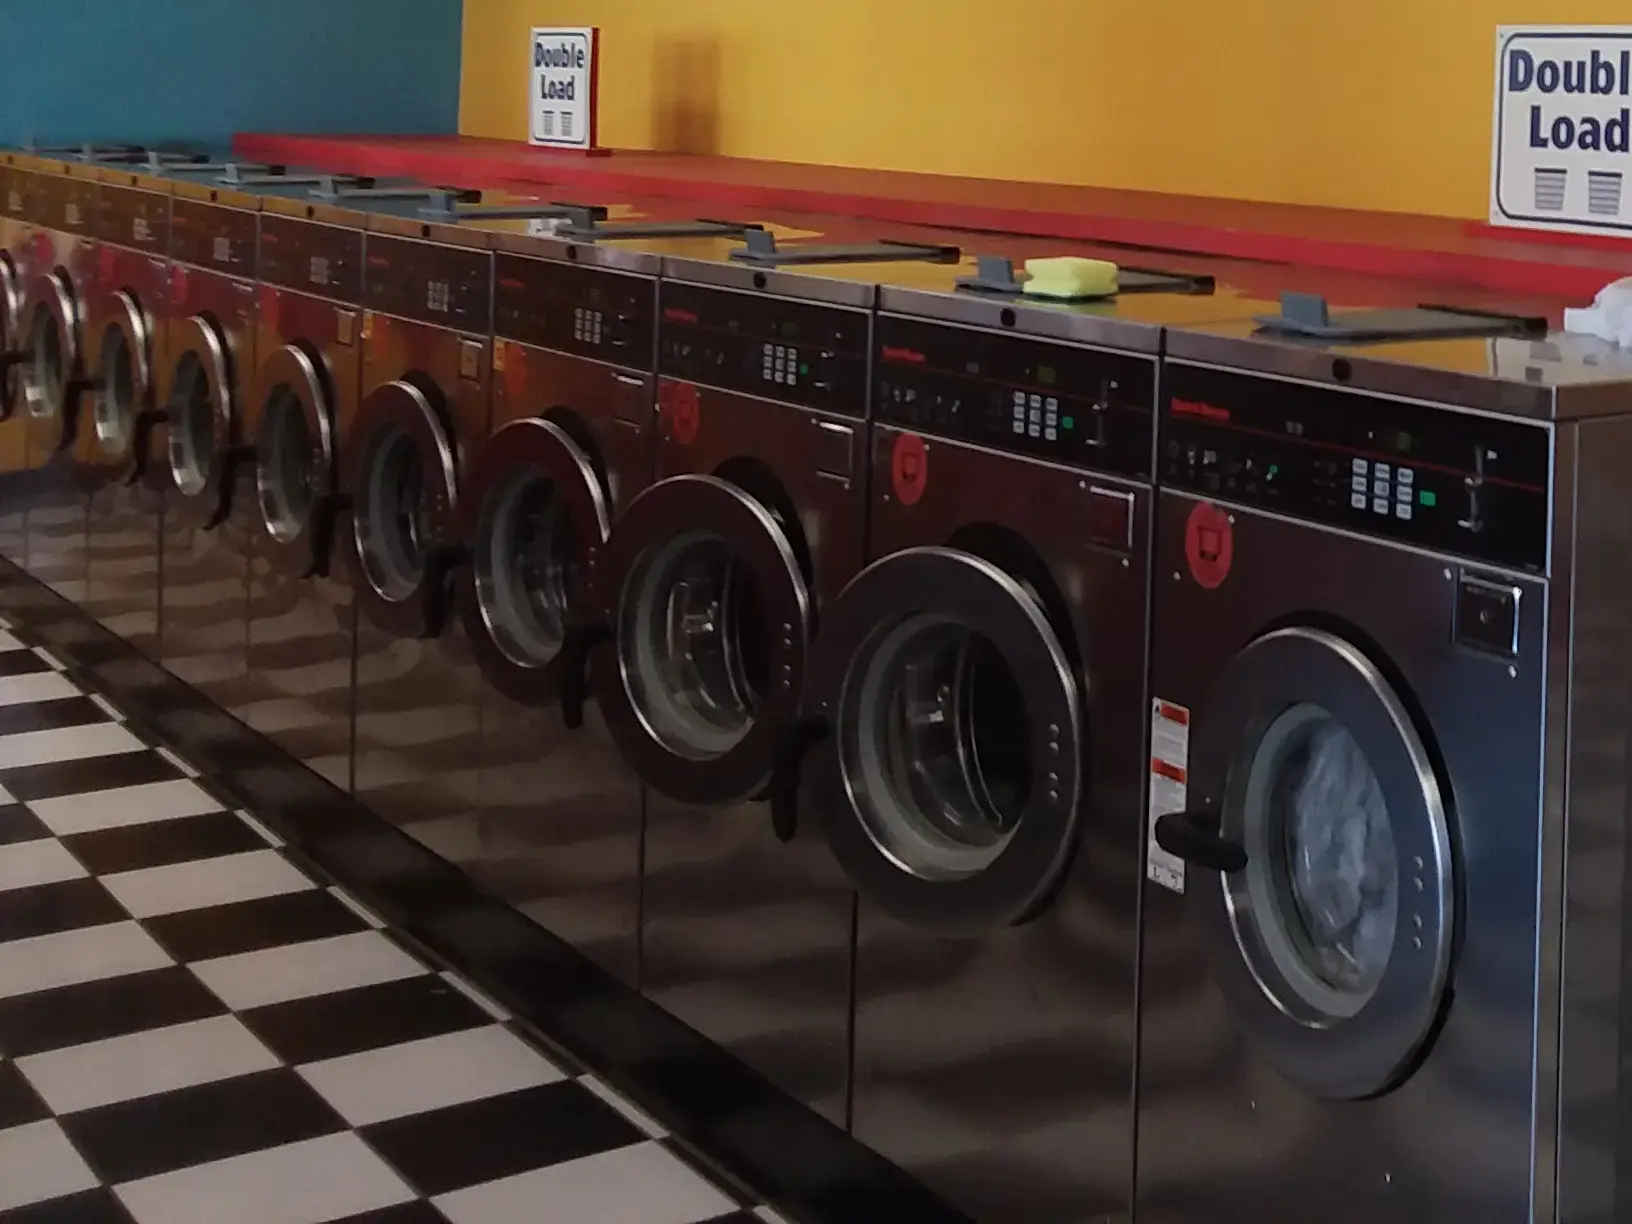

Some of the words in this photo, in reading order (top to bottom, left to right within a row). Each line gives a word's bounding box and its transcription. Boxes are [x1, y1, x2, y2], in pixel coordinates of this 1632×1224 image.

[535, 42, 584, 68] Double
[541, 74, 575, 101] Load
[1530, 105, 1631, 153] Load
